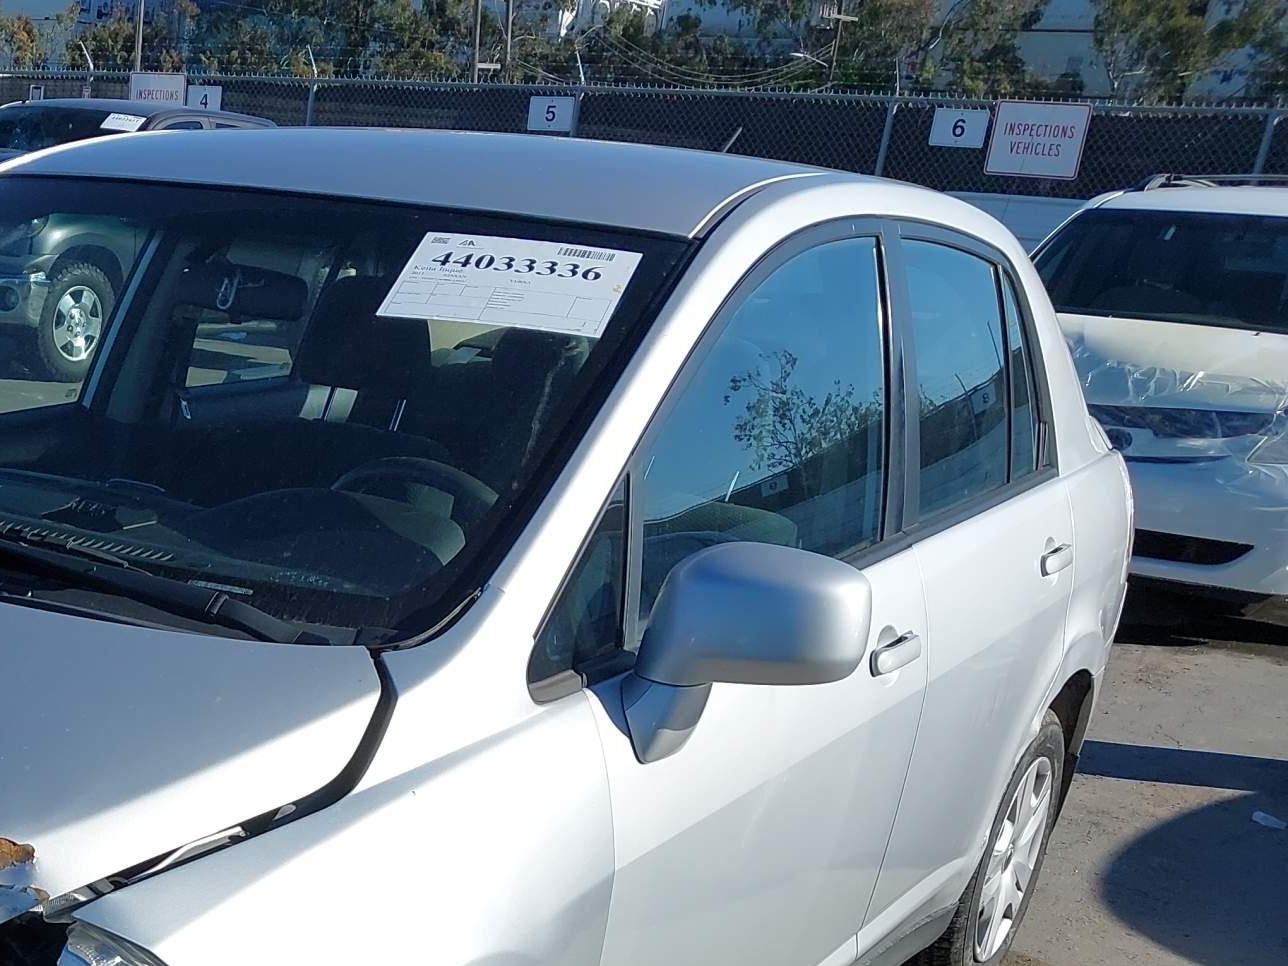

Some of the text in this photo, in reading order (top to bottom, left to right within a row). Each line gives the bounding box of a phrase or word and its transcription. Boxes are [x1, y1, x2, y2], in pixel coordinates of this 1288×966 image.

[135, 87, 179, 101] INSPECTIONS
[199, 93, 209, 108] 4
[545, 105, 557, 122] 5
[952, 118, 966, 138] 6
[1004, 122, 1076, 139] INSPECTIONS
[1009, 140, 1062, 157] VEHICLES
[431, 251, 605, 281] 44033336
